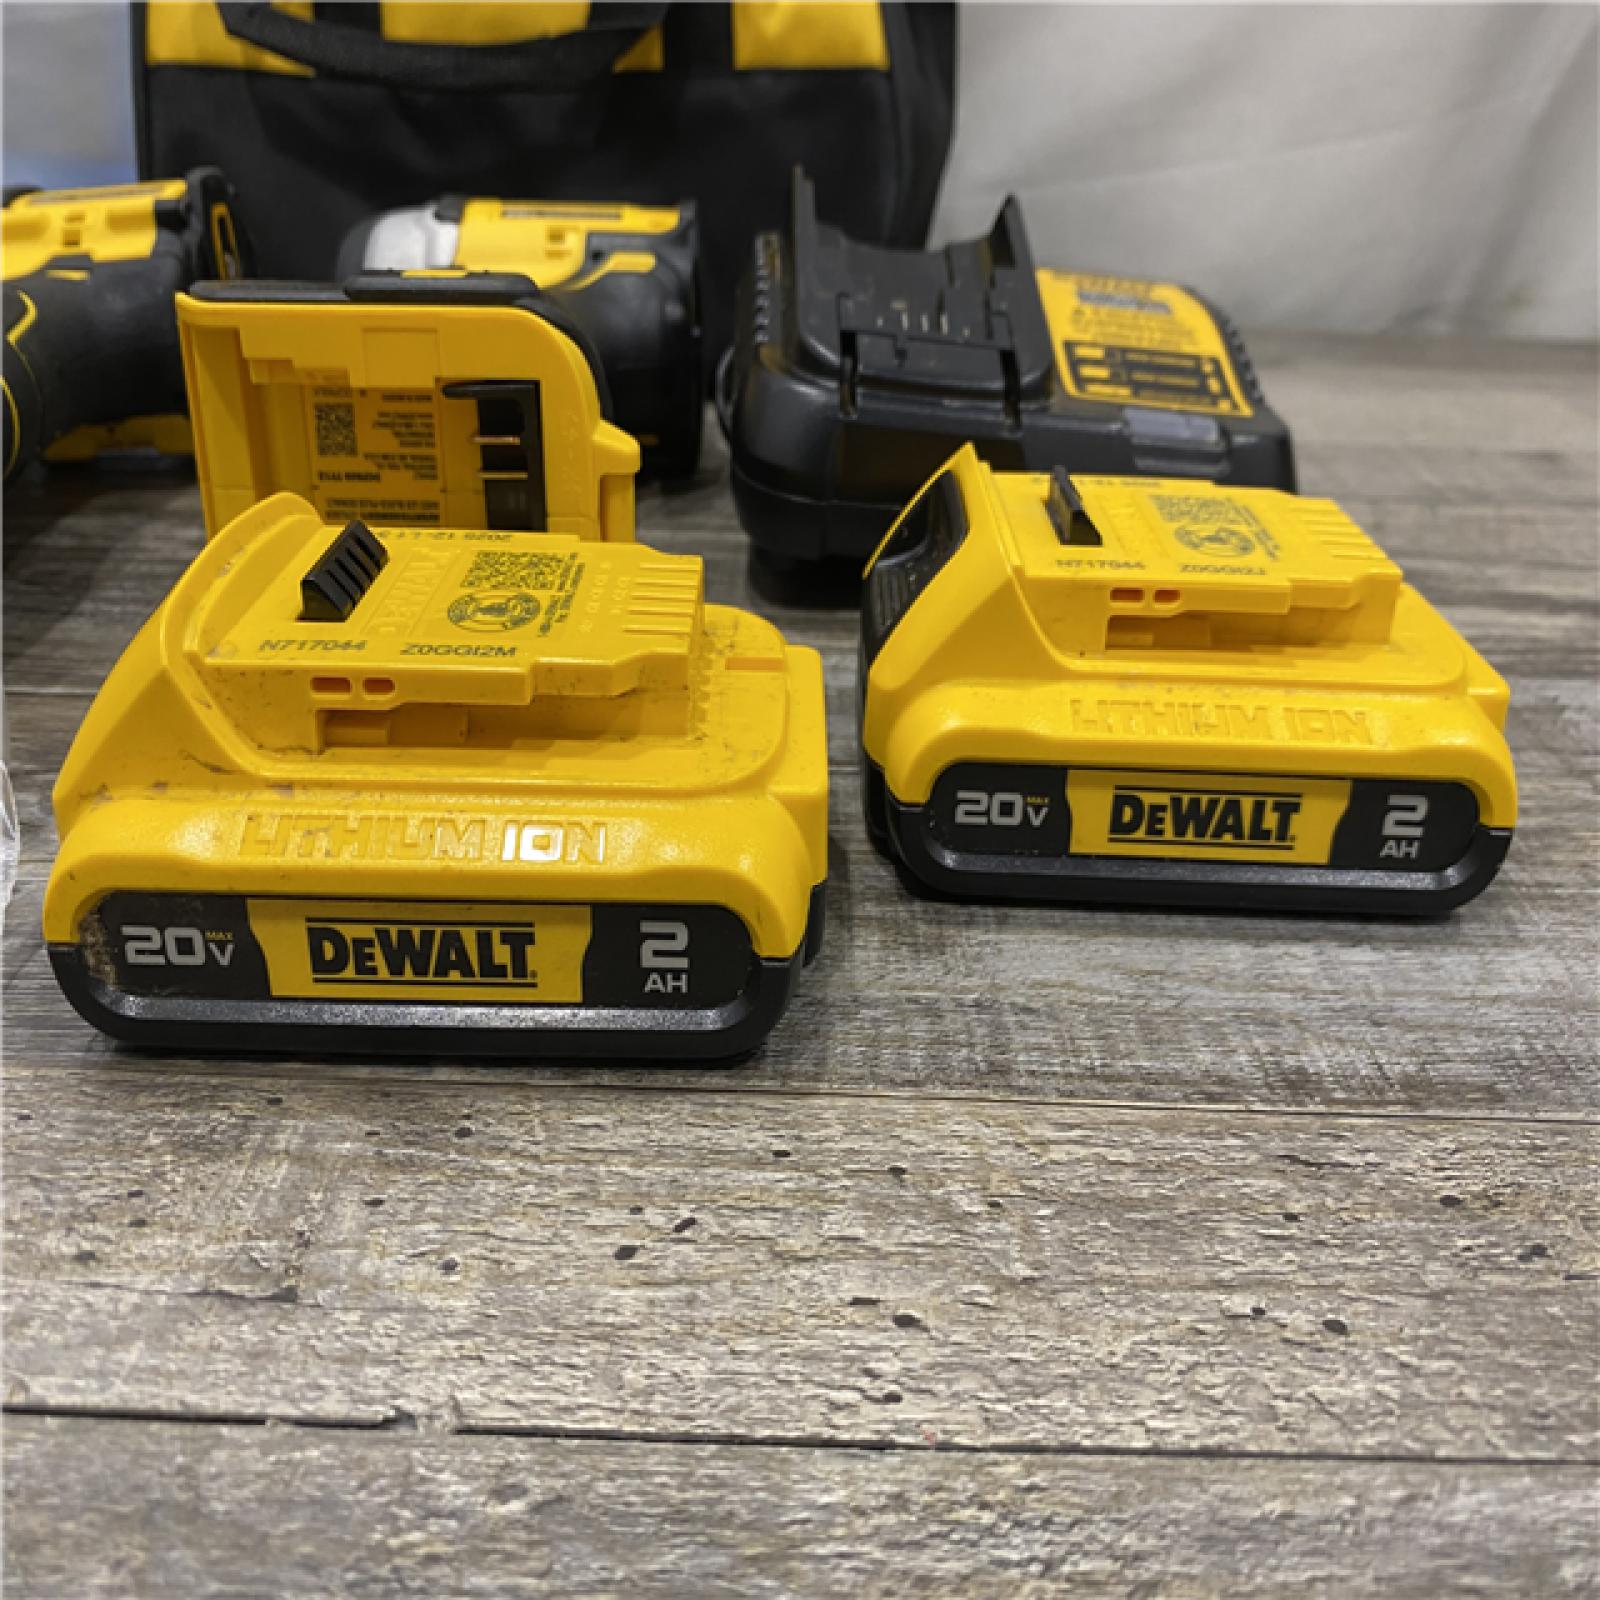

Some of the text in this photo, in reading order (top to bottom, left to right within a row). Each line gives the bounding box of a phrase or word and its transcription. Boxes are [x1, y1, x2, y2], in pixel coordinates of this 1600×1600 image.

[258, 639, 368, 653] N717044
[1069, 698, 1373, 745] LITHIUM ION
[954, 790, 1049, 827] 20V
[1109, 793, 1302, 842] DEWALT
[1381, 794, 1429, 838] 2
[239, 813, 608, 864] LITHIUM ION
[1380, 839, 1420, 859] AH
[119, 924, 236, 967] 20V
[205, 930, 234, 941] MAX
[305, 926, 537, 980] DEWALT
[639, 919, 690, 969] 2
[643, 972, 689, 994] AH
